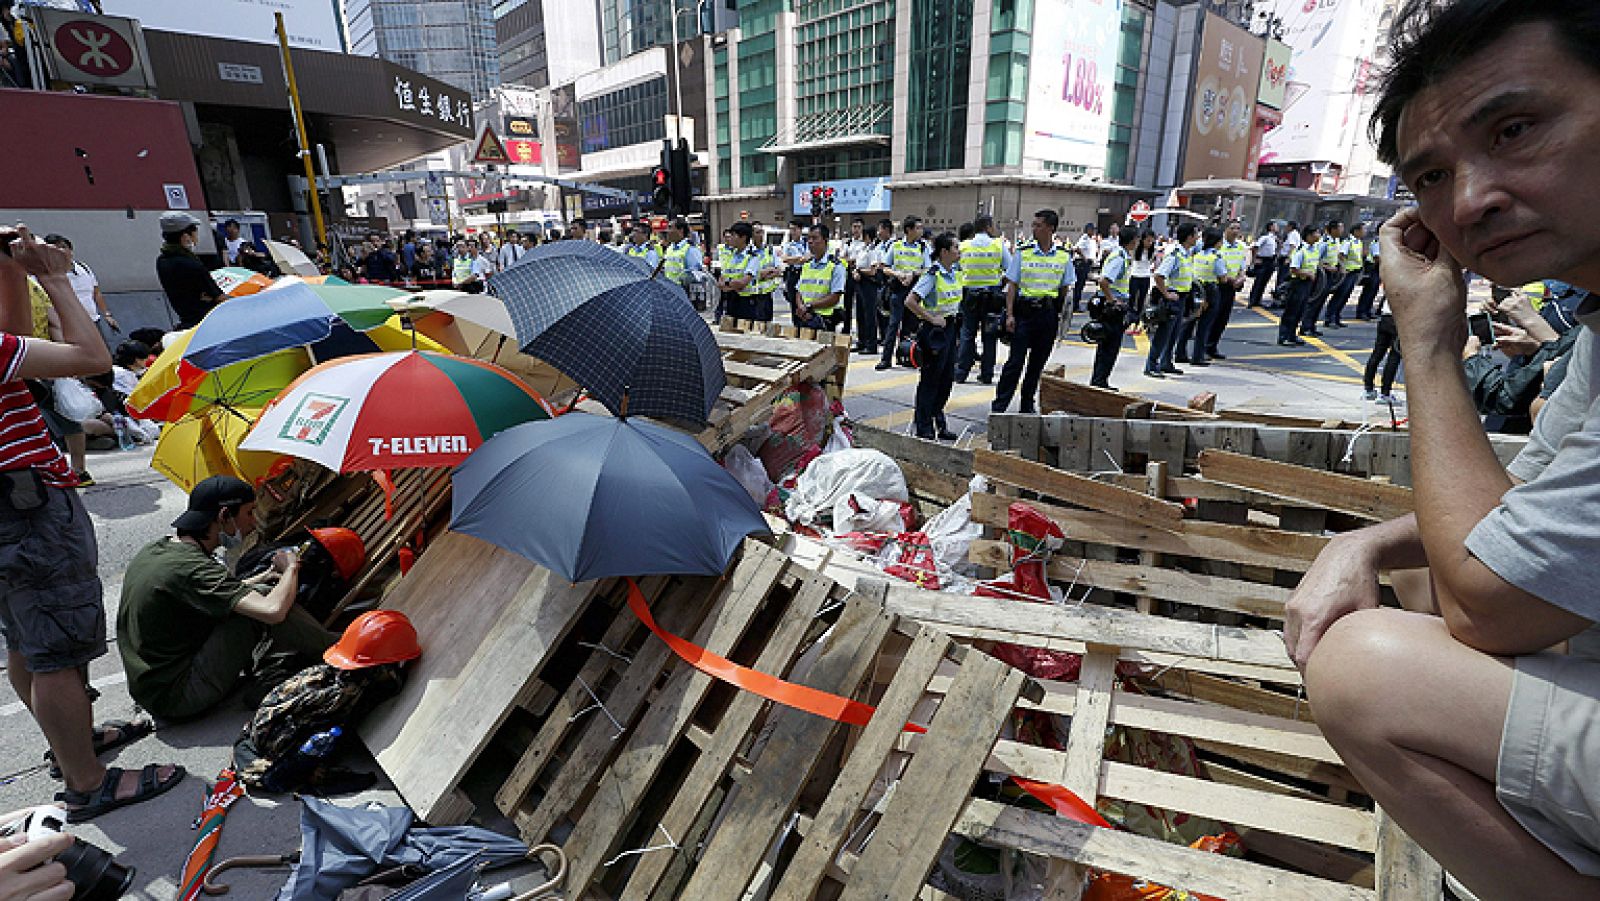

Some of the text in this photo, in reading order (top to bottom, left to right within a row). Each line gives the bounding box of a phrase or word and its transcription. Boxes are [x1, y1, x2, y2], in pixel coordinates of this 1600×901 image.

[394, 76, 470, 128] 恒生銀行
[1062, 51, 1104, 115] 1.88%
